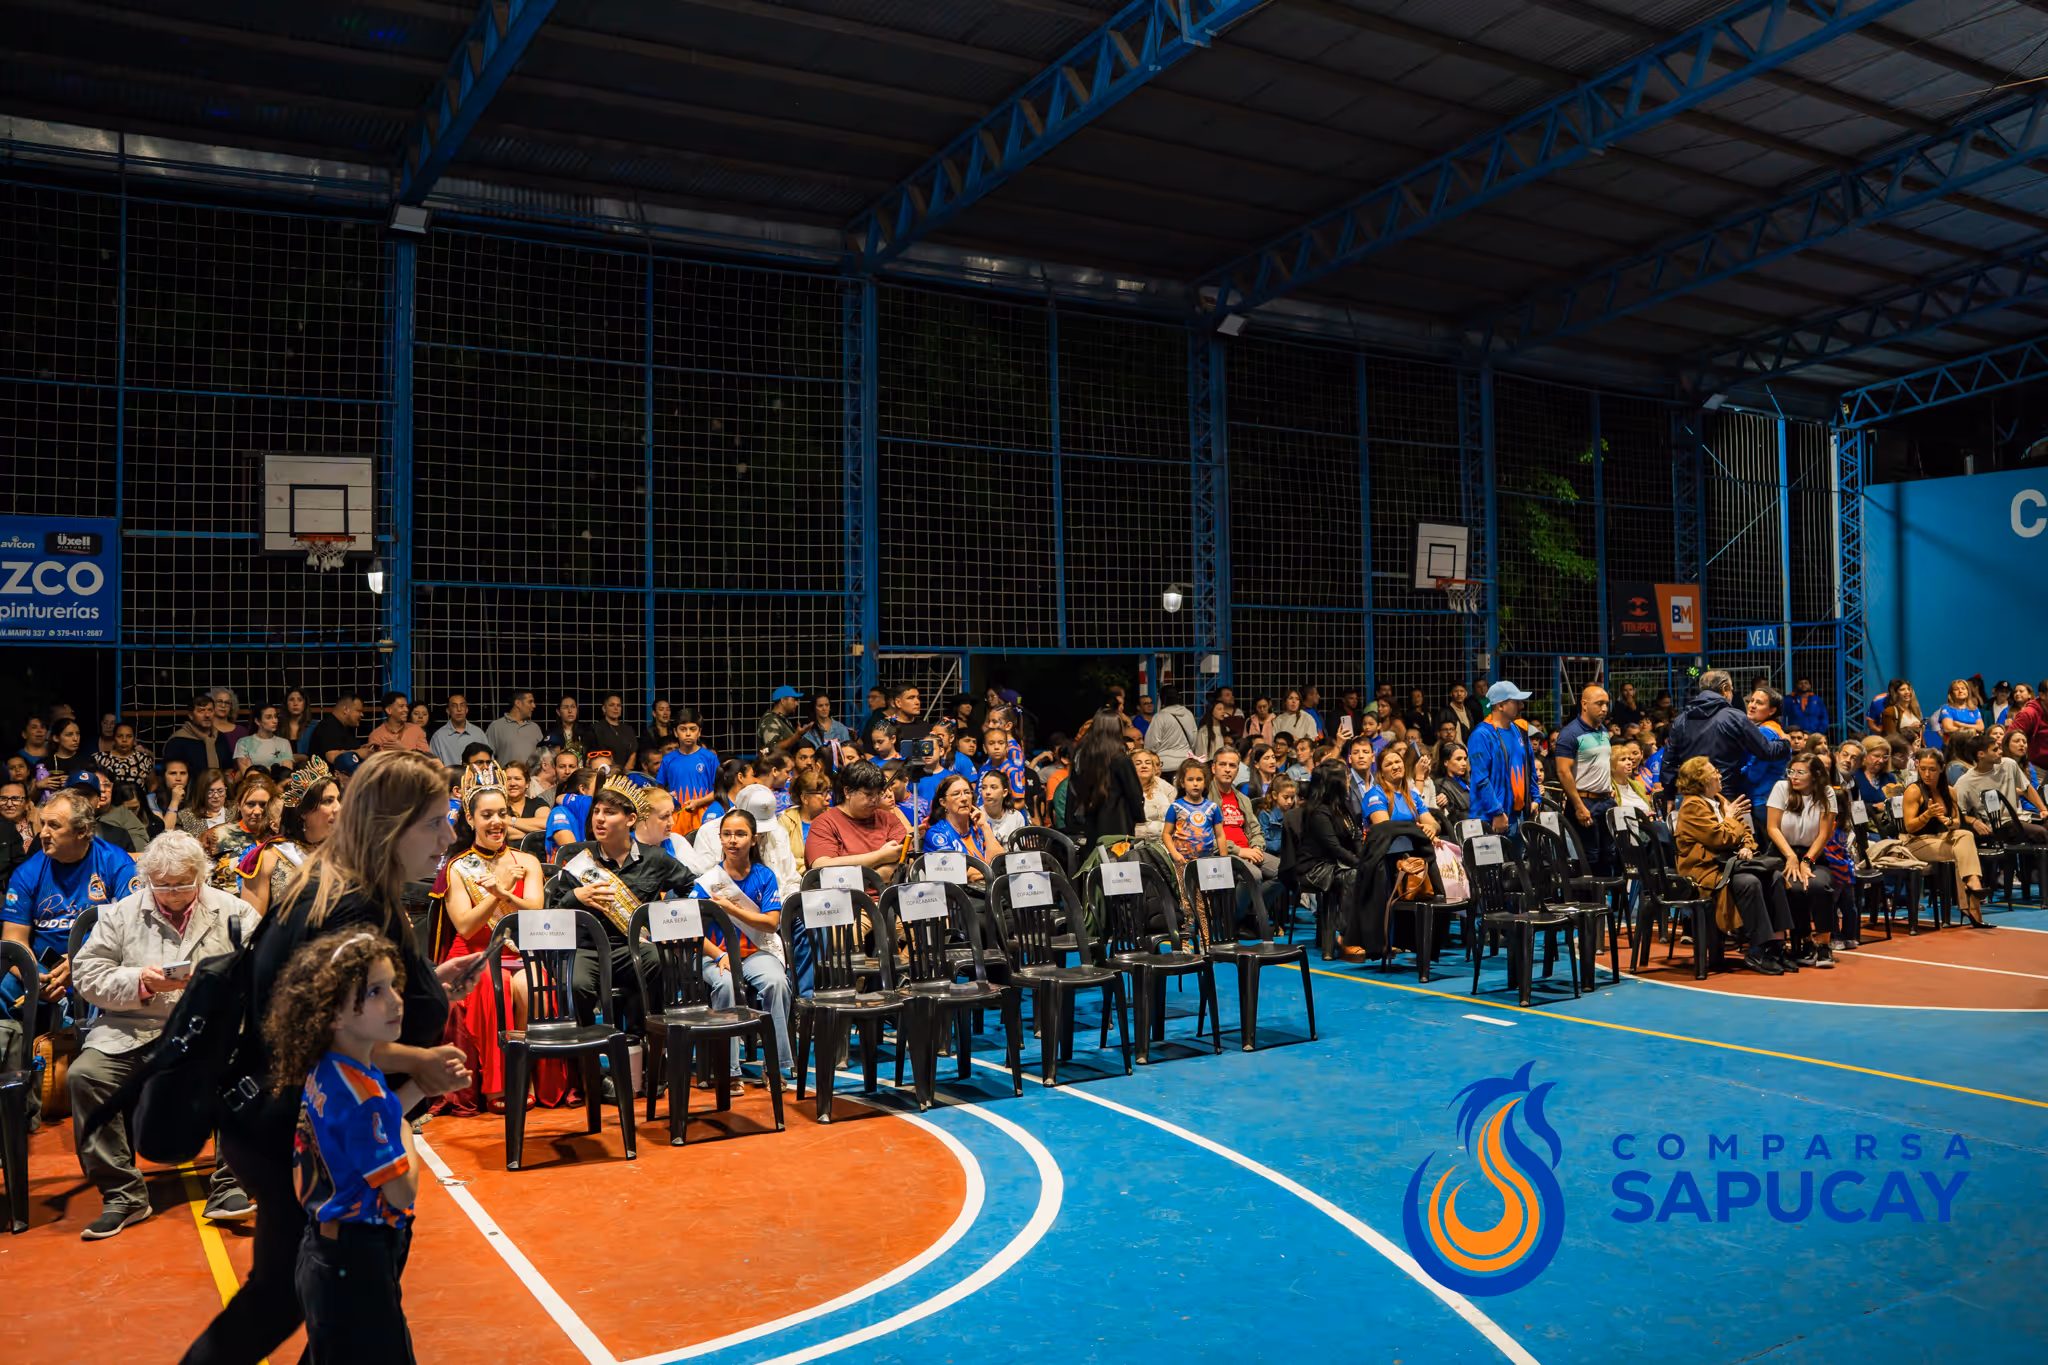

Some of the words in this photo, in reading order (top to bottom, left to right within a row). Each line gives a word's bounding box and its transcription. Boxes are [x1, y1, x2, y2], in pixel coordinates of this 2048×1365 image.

[0, 561, 104, 596] ZCO
[0, 602, 99, 621] pinturerías
[1672, 605, 1692, 624] BM
[32, 629, 46, 637] 337
[1748, 629, 1775, 647] VELA
